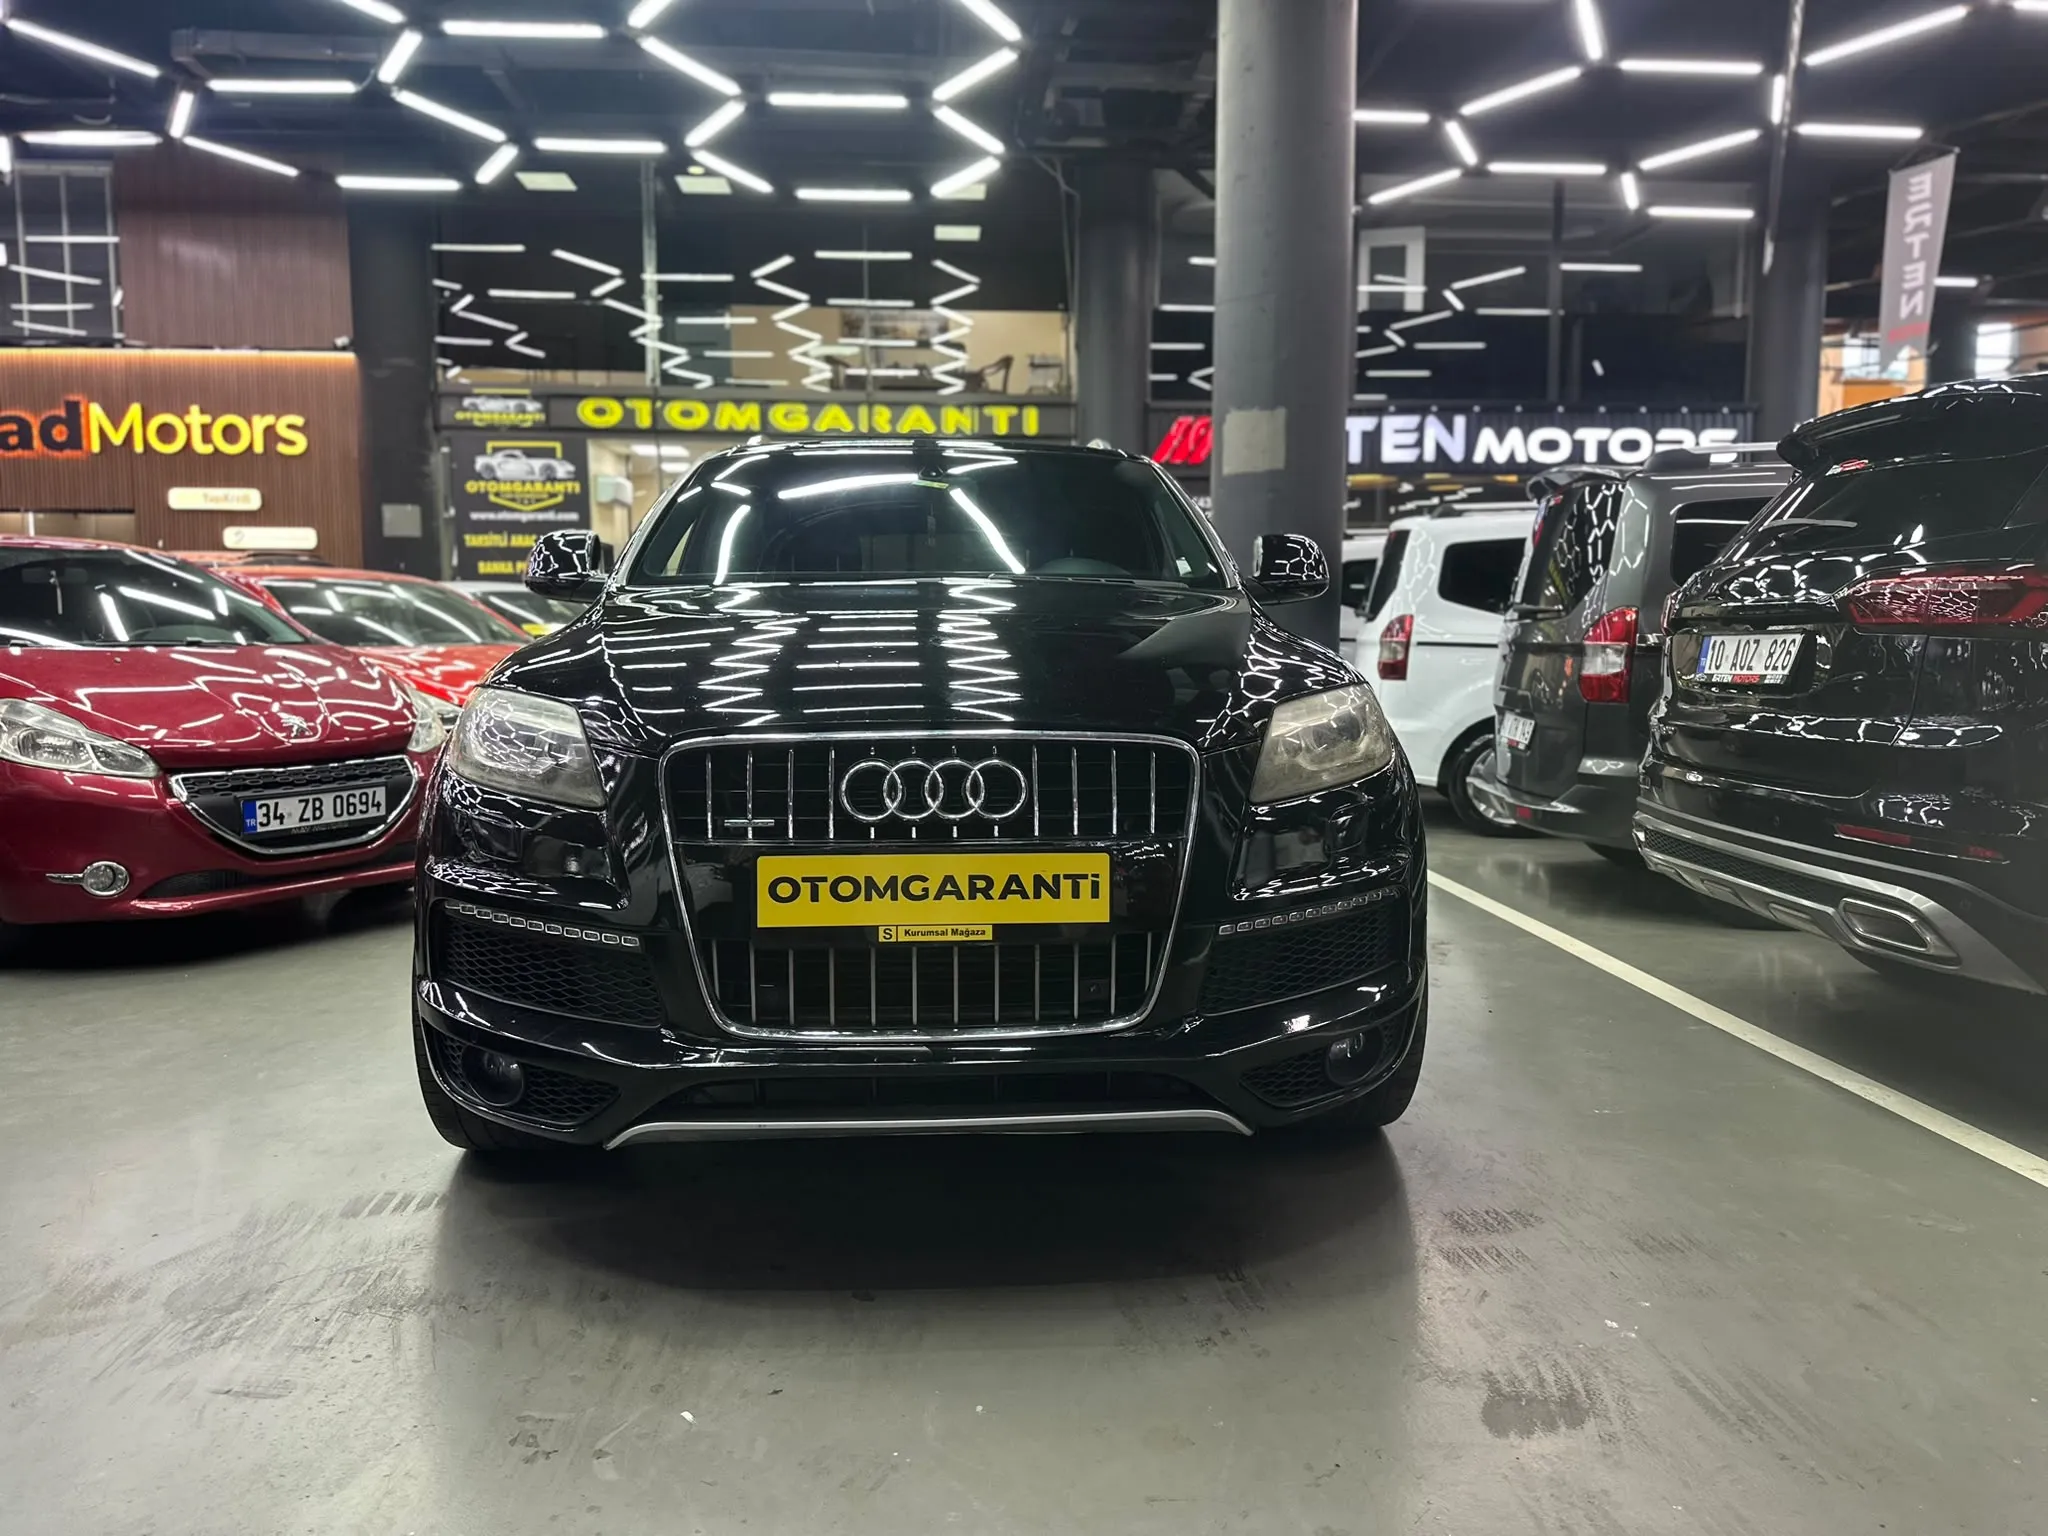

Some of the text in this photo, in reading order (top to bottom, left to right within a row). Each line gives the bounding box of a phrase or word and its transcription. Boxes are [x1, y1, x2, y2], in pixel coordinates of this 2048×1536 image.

[577, 397, 1039, 436] OTOMGARANTI
[1708, 639, 1726, 671] 10
[1763, 638, 1796, 671] 826
[257, 801, 285, 828] 34
[298, 797, 324, 823] ZB
[333, 790, 383, 819] 0694
[882, 927, 987, 940] S Kurumsal Mağaza
